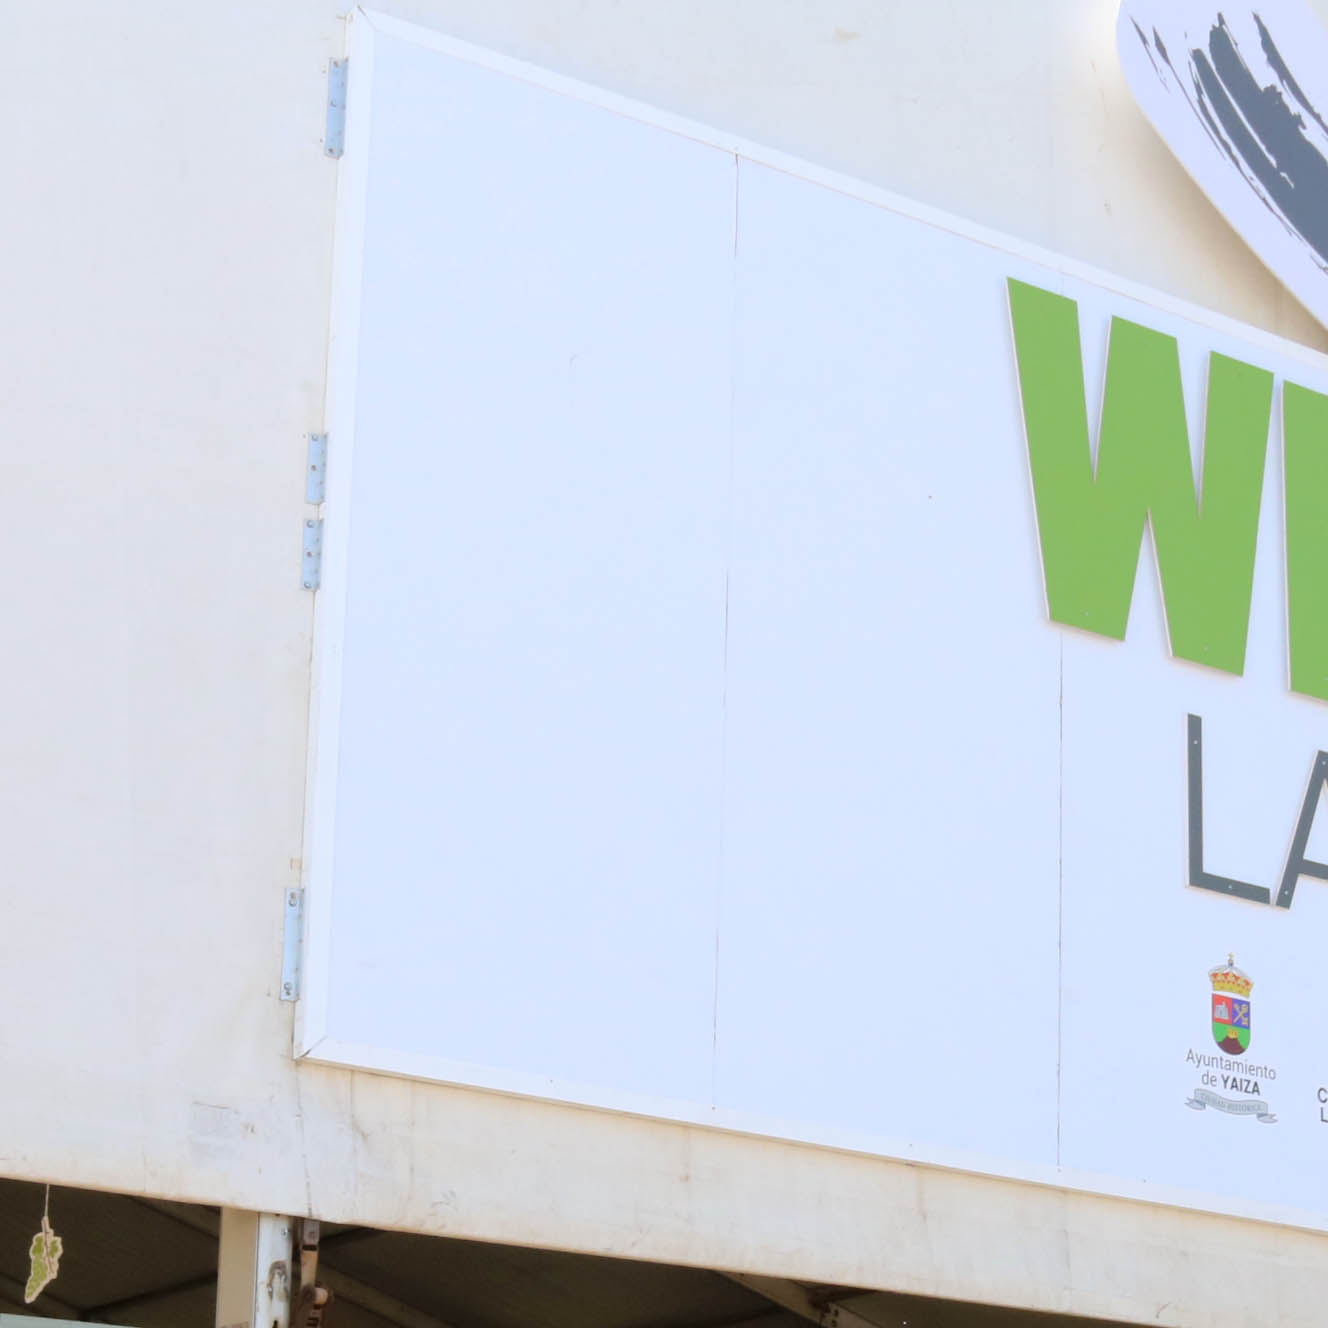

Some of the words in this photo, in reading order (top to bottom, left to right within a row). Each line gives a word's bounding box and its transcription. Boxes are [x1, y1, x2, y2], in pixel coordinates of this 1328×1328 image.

[1186, 1048, 1276, 1080] Ayuntamiento
[1201, 1071, 1217, 1087] de
[1221, 1074, 1260, 1096] YAIZA
